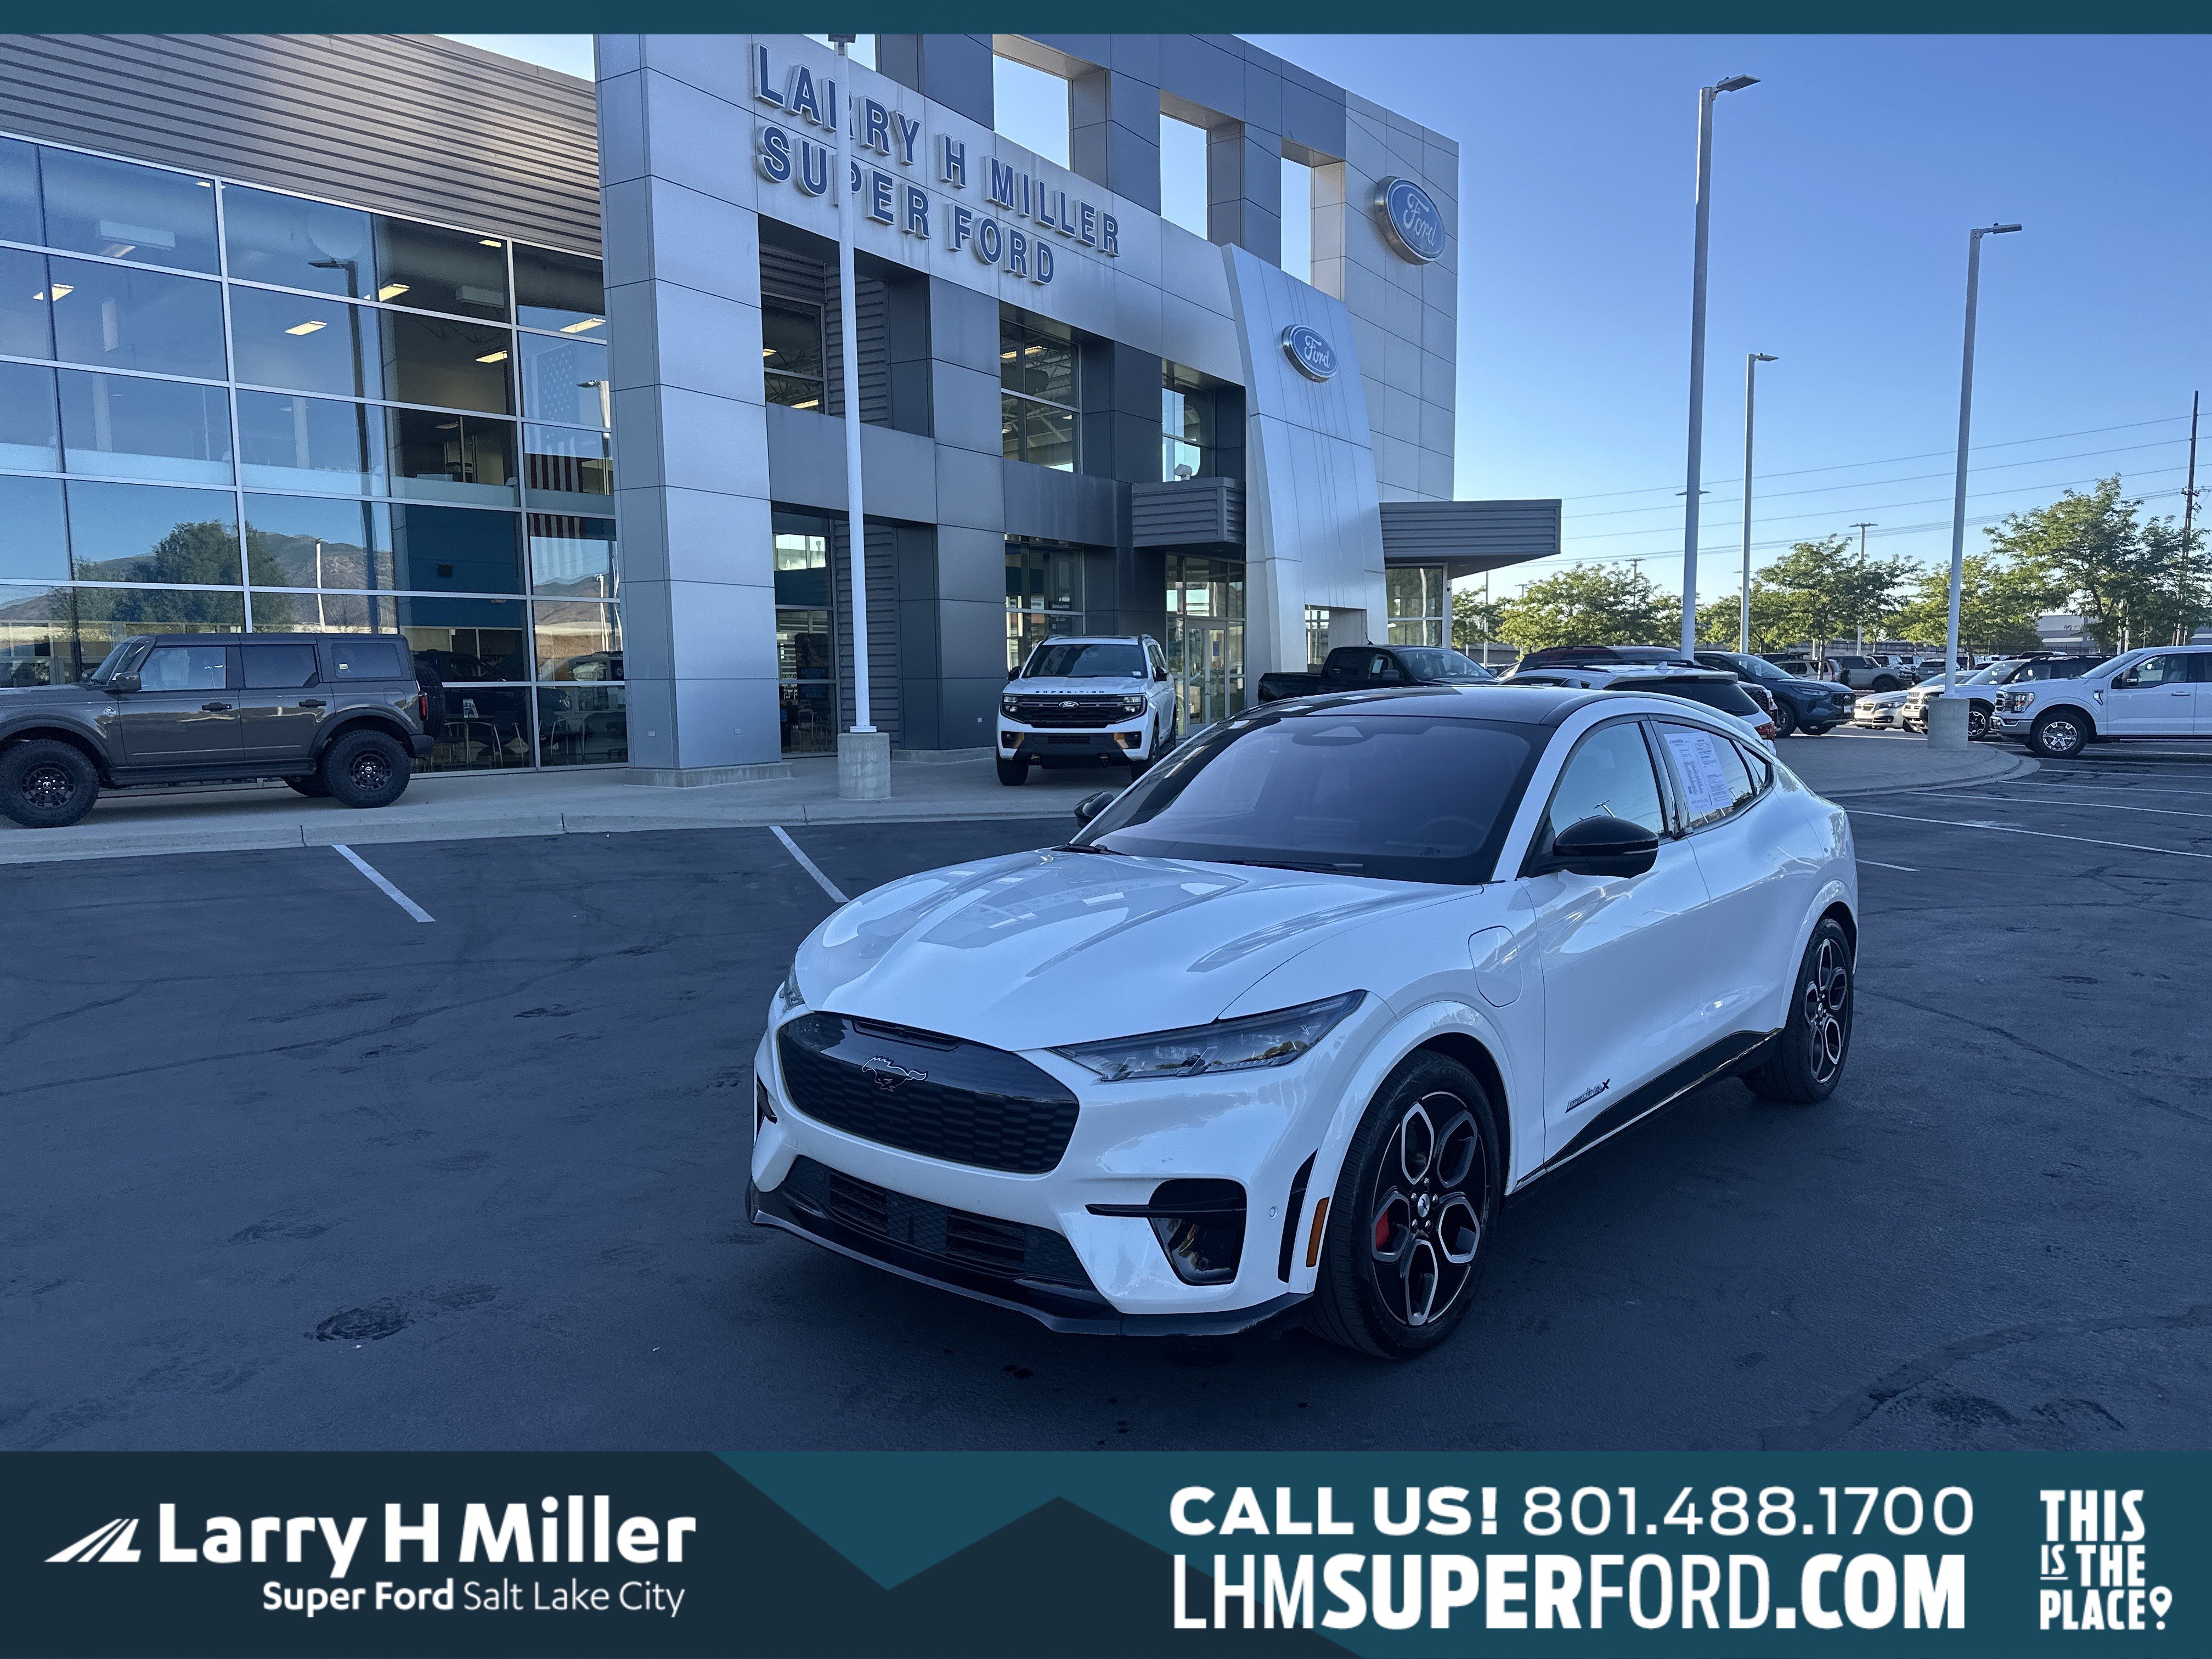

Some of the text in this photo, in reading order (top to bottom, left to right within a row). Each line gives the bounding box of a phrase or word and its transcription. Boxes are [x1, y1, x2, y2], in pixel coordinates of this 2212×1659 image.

[939, 134, 966, 188] H
[986, 156, 1119, 257] MILLER
[1403, 193, 1437, 246] Ford
[949, 204, 1054, 284] FORD
[1304, 335, 1331, 369] Ford
